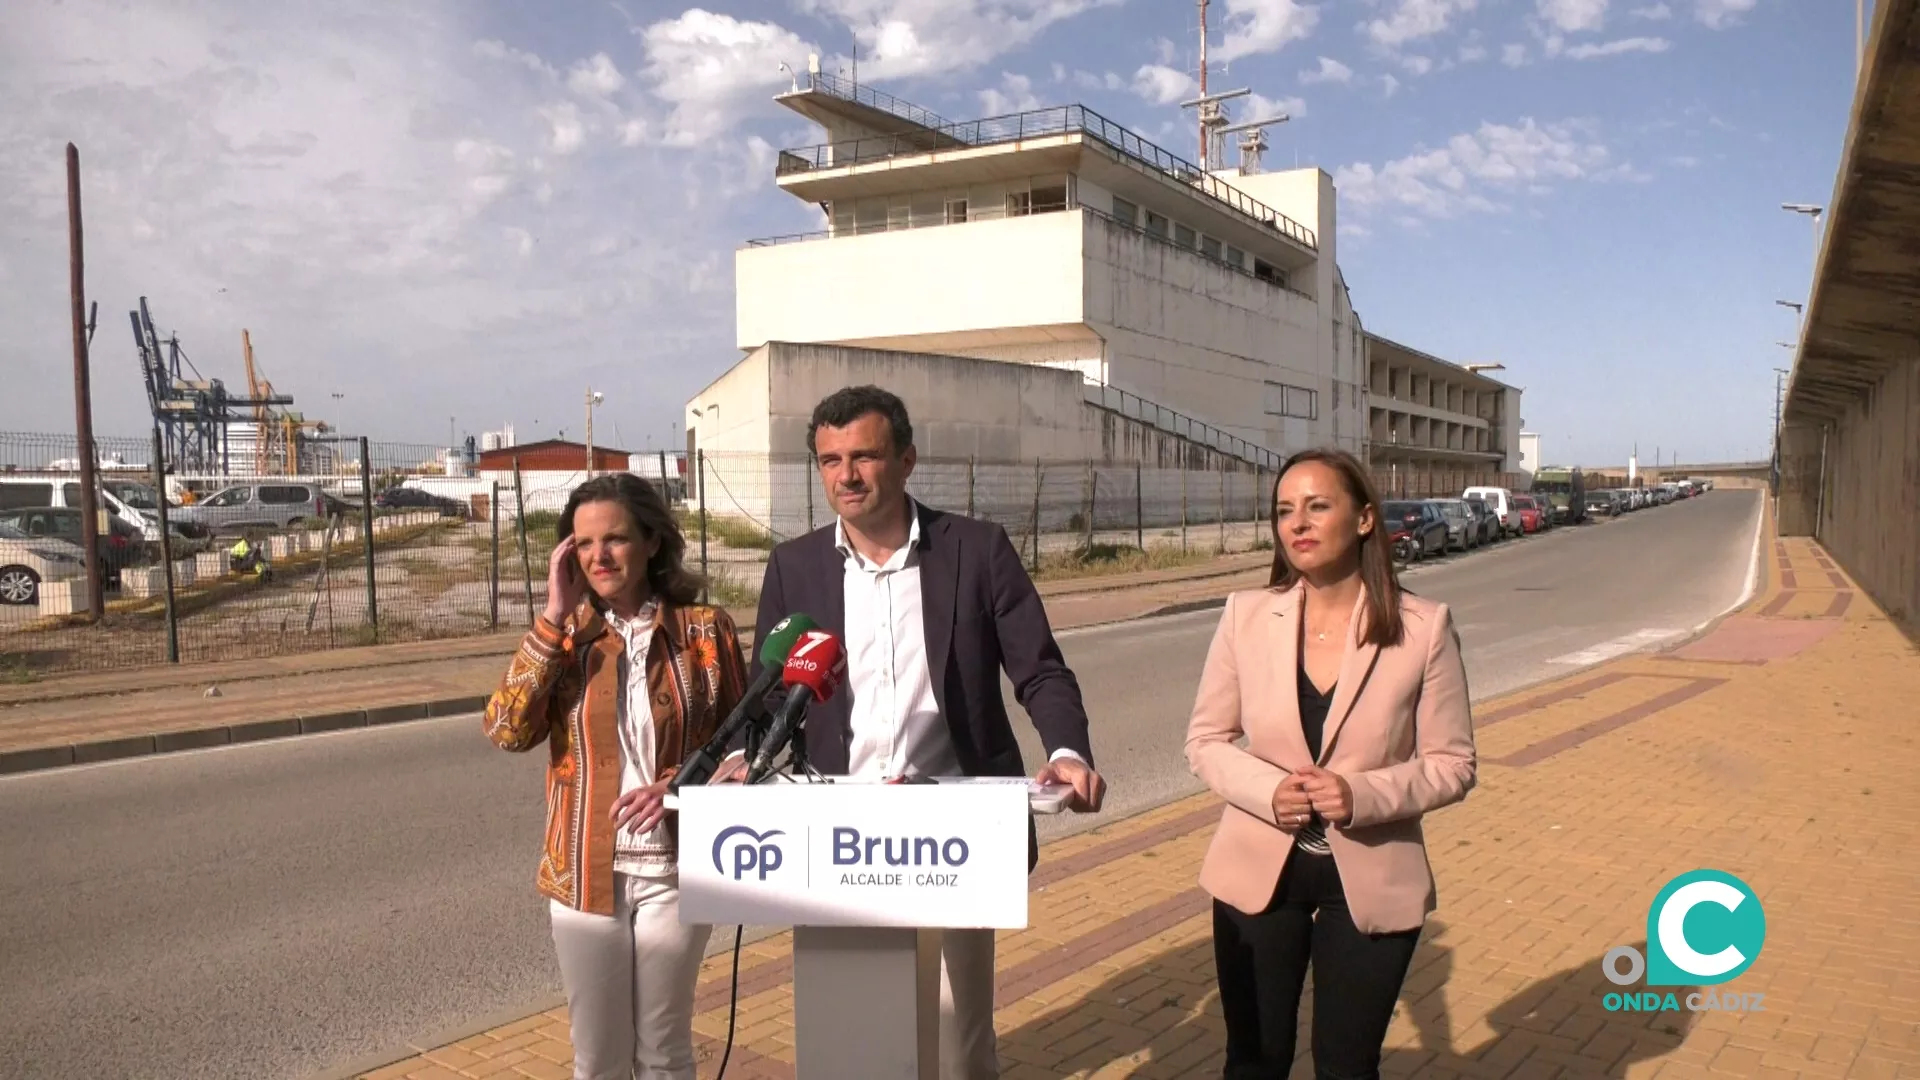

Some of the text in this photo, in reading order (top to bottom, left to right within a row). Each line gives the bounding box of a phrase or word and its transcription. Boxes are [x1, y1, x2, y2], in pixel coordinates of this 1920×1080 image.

[793, 631, 833, 658] 7
[832, 827, 970, 868] Bruno
[840, 871, 959, 887] ALCALDE CÁDIZ
